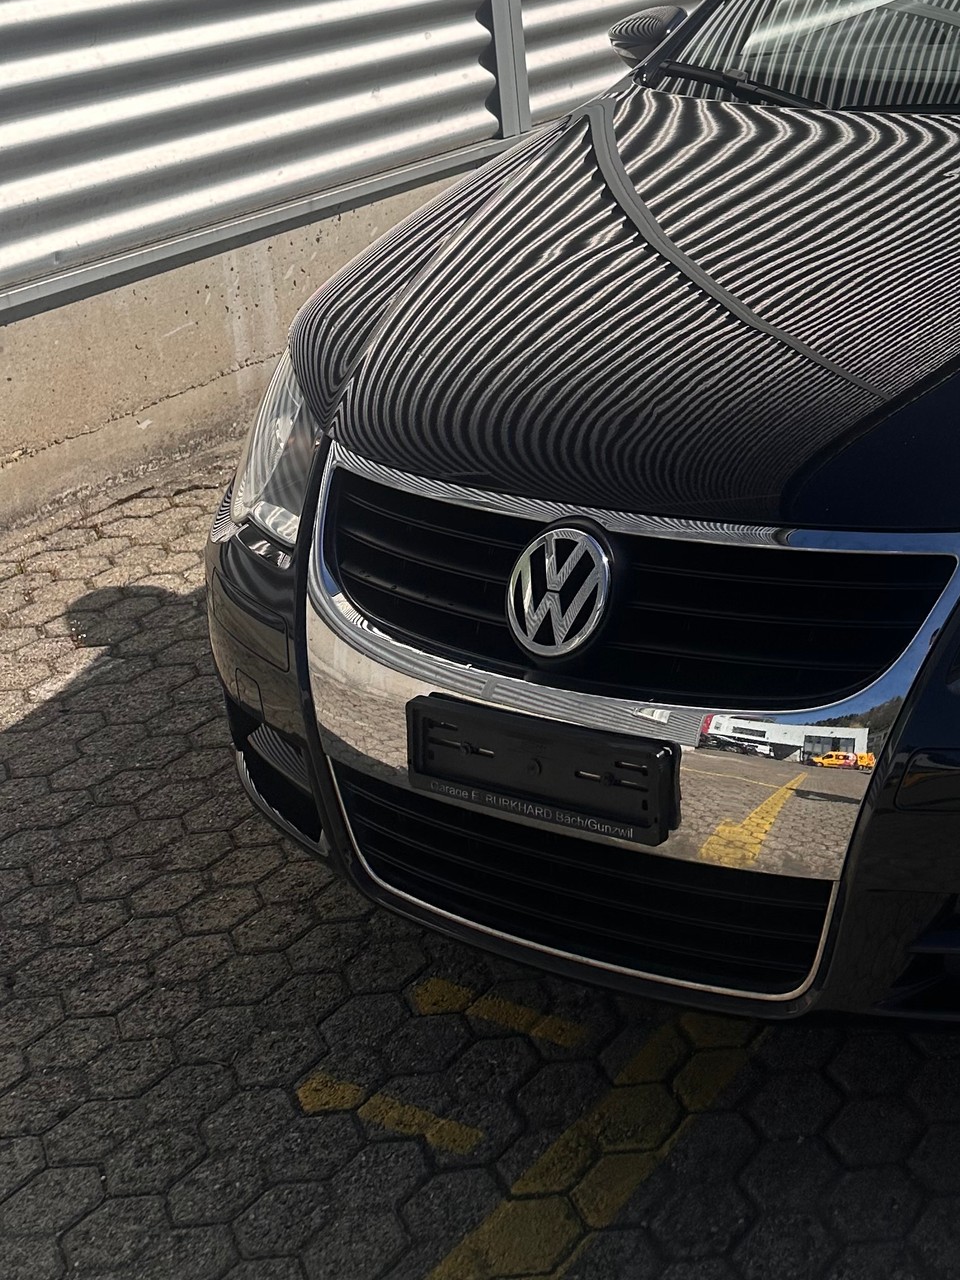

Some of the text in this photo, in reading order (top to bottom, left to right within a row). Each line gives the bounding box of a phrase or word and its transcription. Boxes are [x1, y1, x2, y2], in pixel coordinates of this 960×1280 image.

[507, 527, 612, 657] VW
[430, 780, 469, 799] Garage
[485, 794, 553, 820] BURKHARD
[555, 810, 634, 839] Bach/Gunzwil
